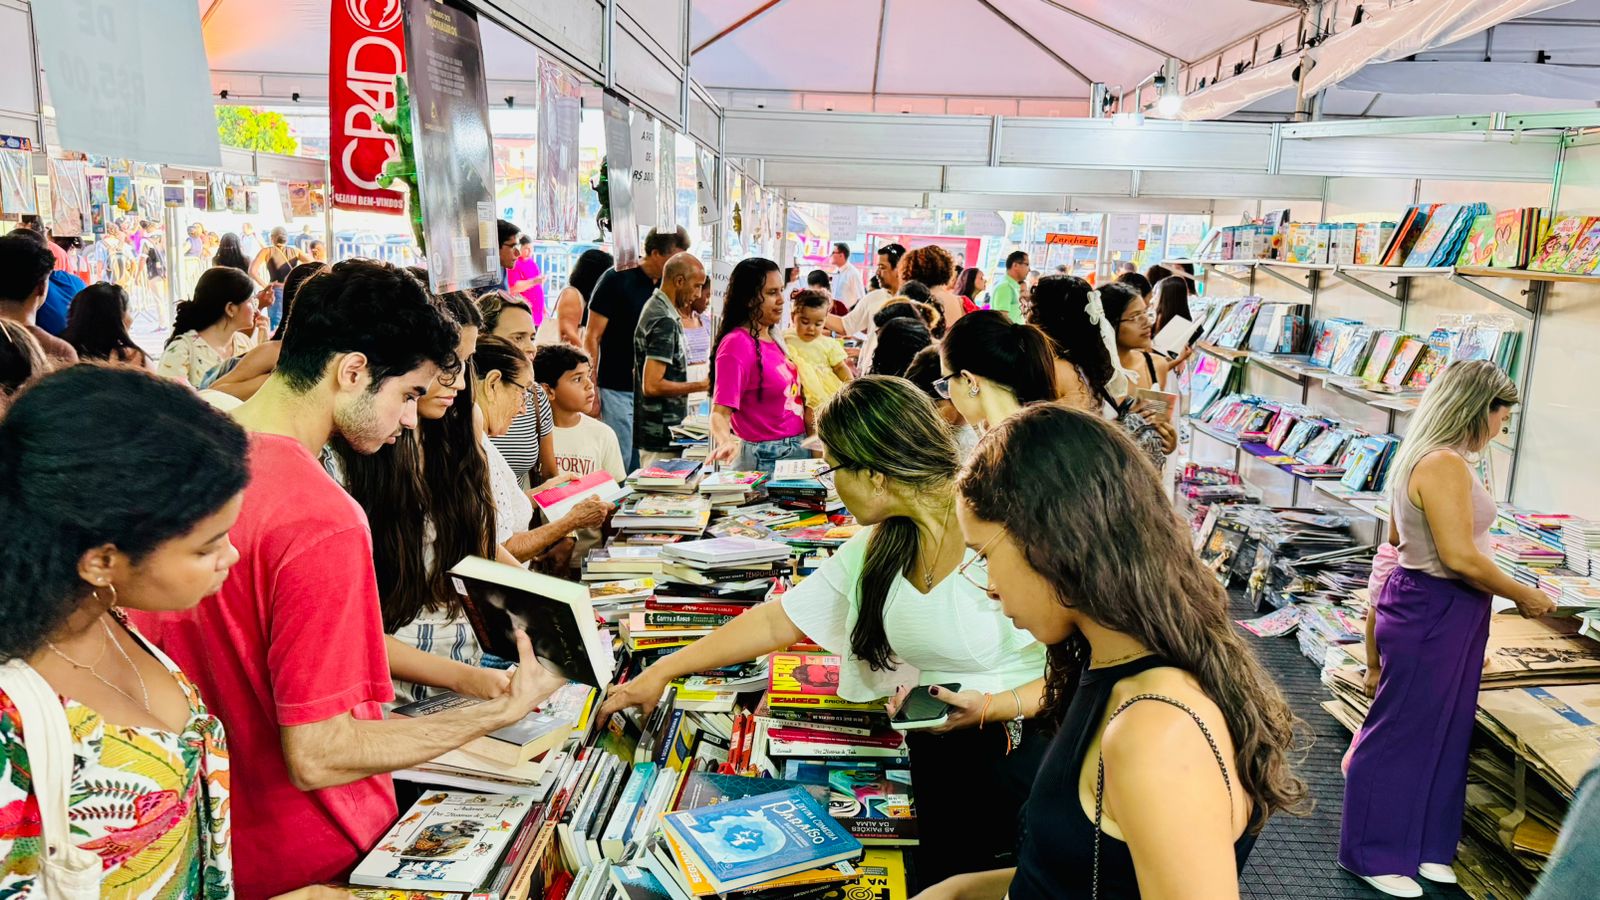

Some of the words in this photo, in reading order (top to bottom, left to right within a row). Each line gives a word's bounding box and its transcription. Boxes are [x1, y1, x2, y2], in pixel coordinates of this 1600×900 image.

[341, 36, 402, 191] CPAD
[335, 193, 357, 205] SEJAM
[358, 196, 403, 209] BEM-VINDOS
[1048, 234, 1088, 245] Lanches
[761, 800, 825, 844] PARAÍSO
